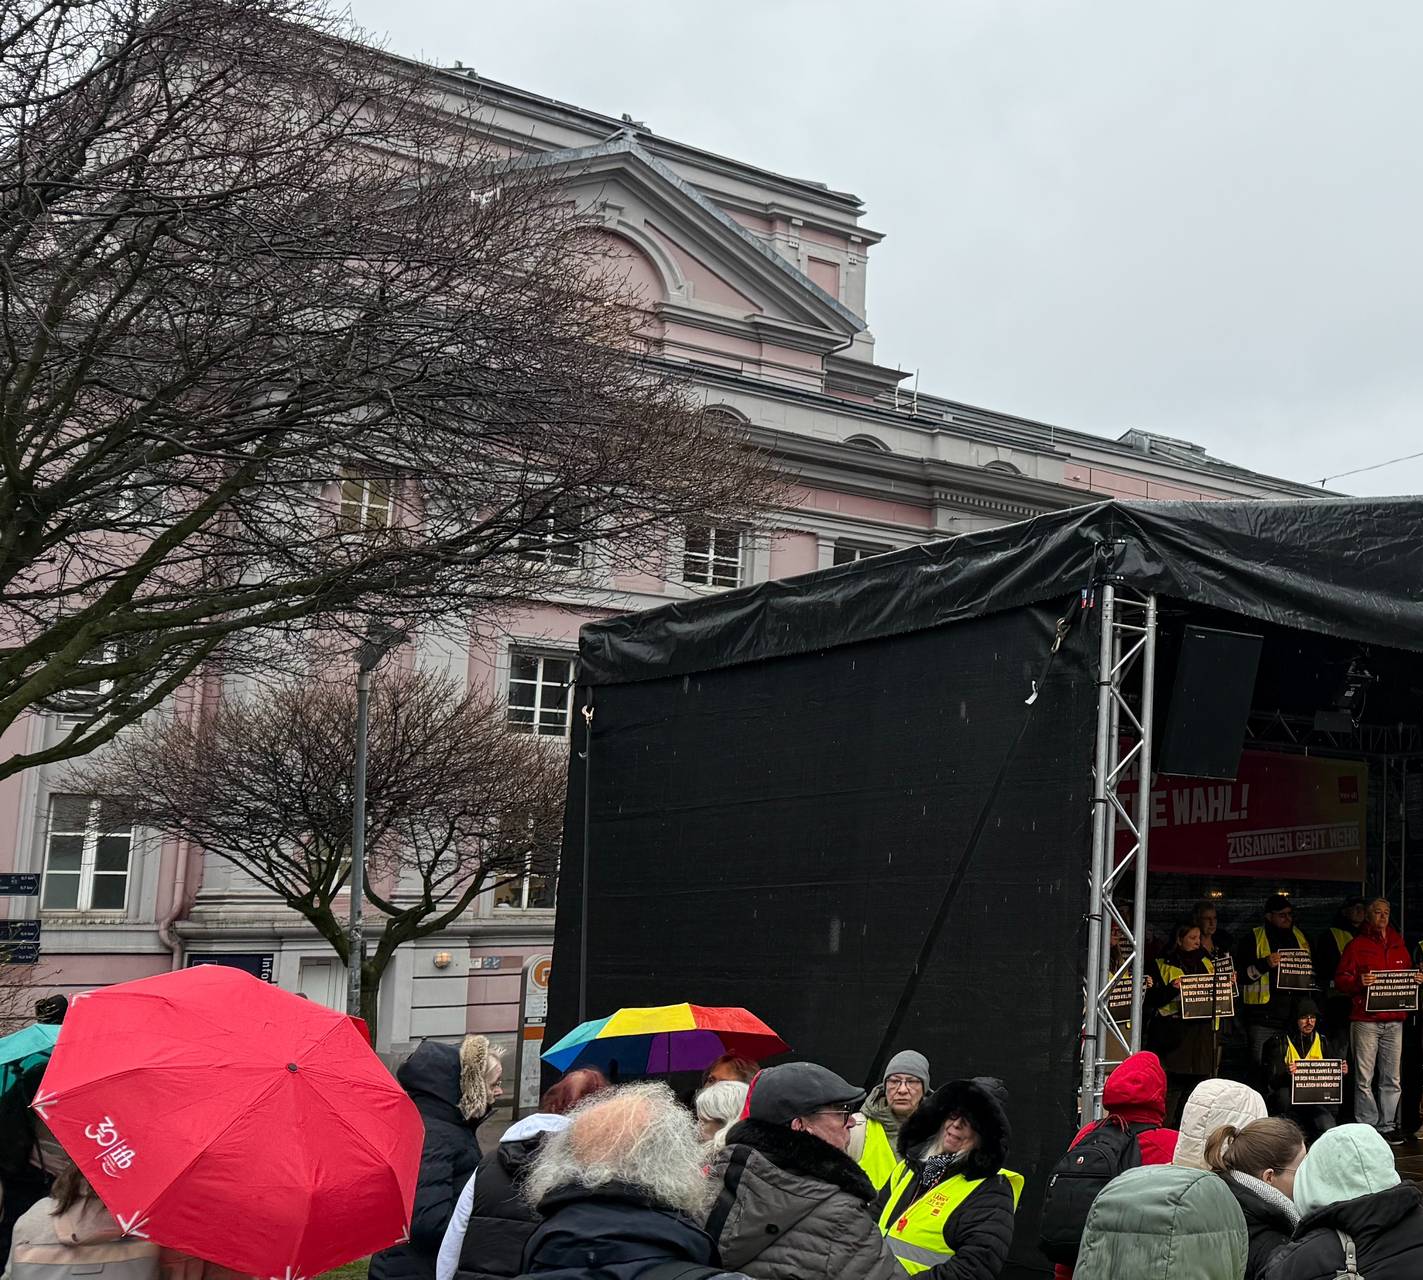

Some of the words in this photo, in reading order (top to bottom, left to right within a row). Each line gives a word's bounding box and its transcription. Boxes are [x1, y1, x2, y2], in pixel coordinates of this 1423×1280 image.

[1172, 784, 1250, 826] WAHL!
[1228, 832, 1294, 858] ZUSAMMEN
[1296, 829, 1328, 851] GEHT
[1328, 826, 1361, 849] MEHR
[261, 957, 273, 980] Info
